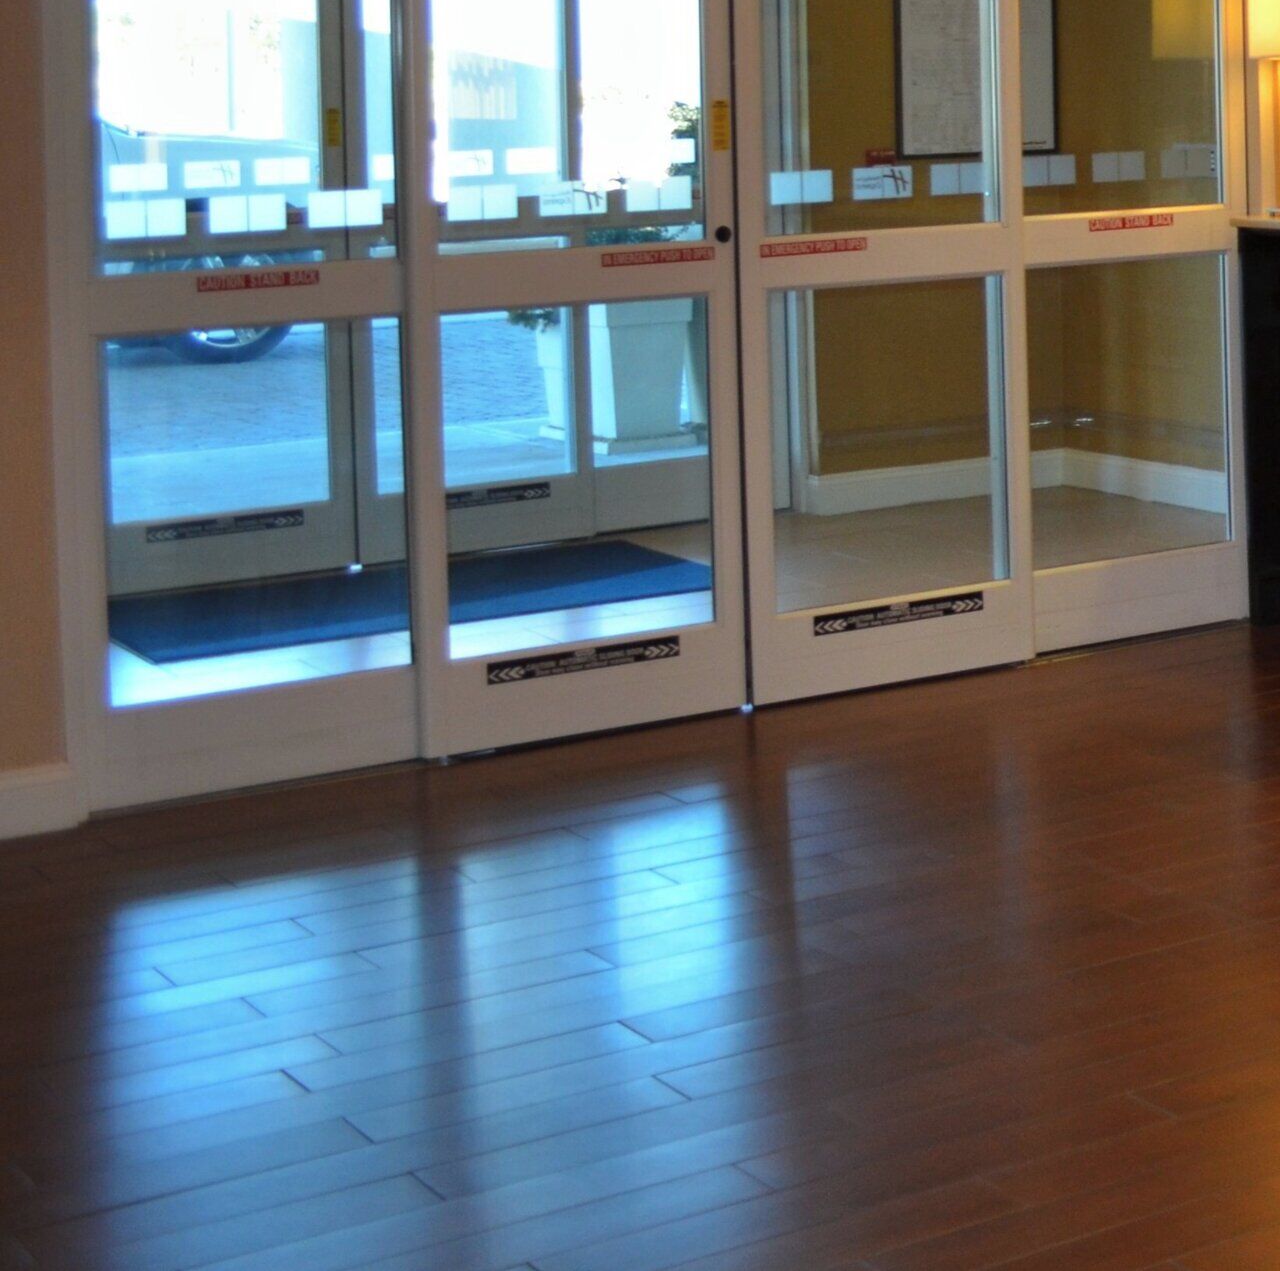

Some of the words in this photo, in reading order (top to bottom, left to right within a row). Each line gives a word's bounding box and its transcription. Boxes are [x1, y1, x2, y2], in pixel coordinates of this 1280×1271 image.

[1091, 218, 1122, 230] CAUTION
[1125, 216, 1149, 228] STAND
[771, 242, 813, 255] EMERGENCY
[613, 251, 658, 265] EMERGENCY
[199, 274, 246, 291] CAUTION
[250, 272, 285, 288] STAND
